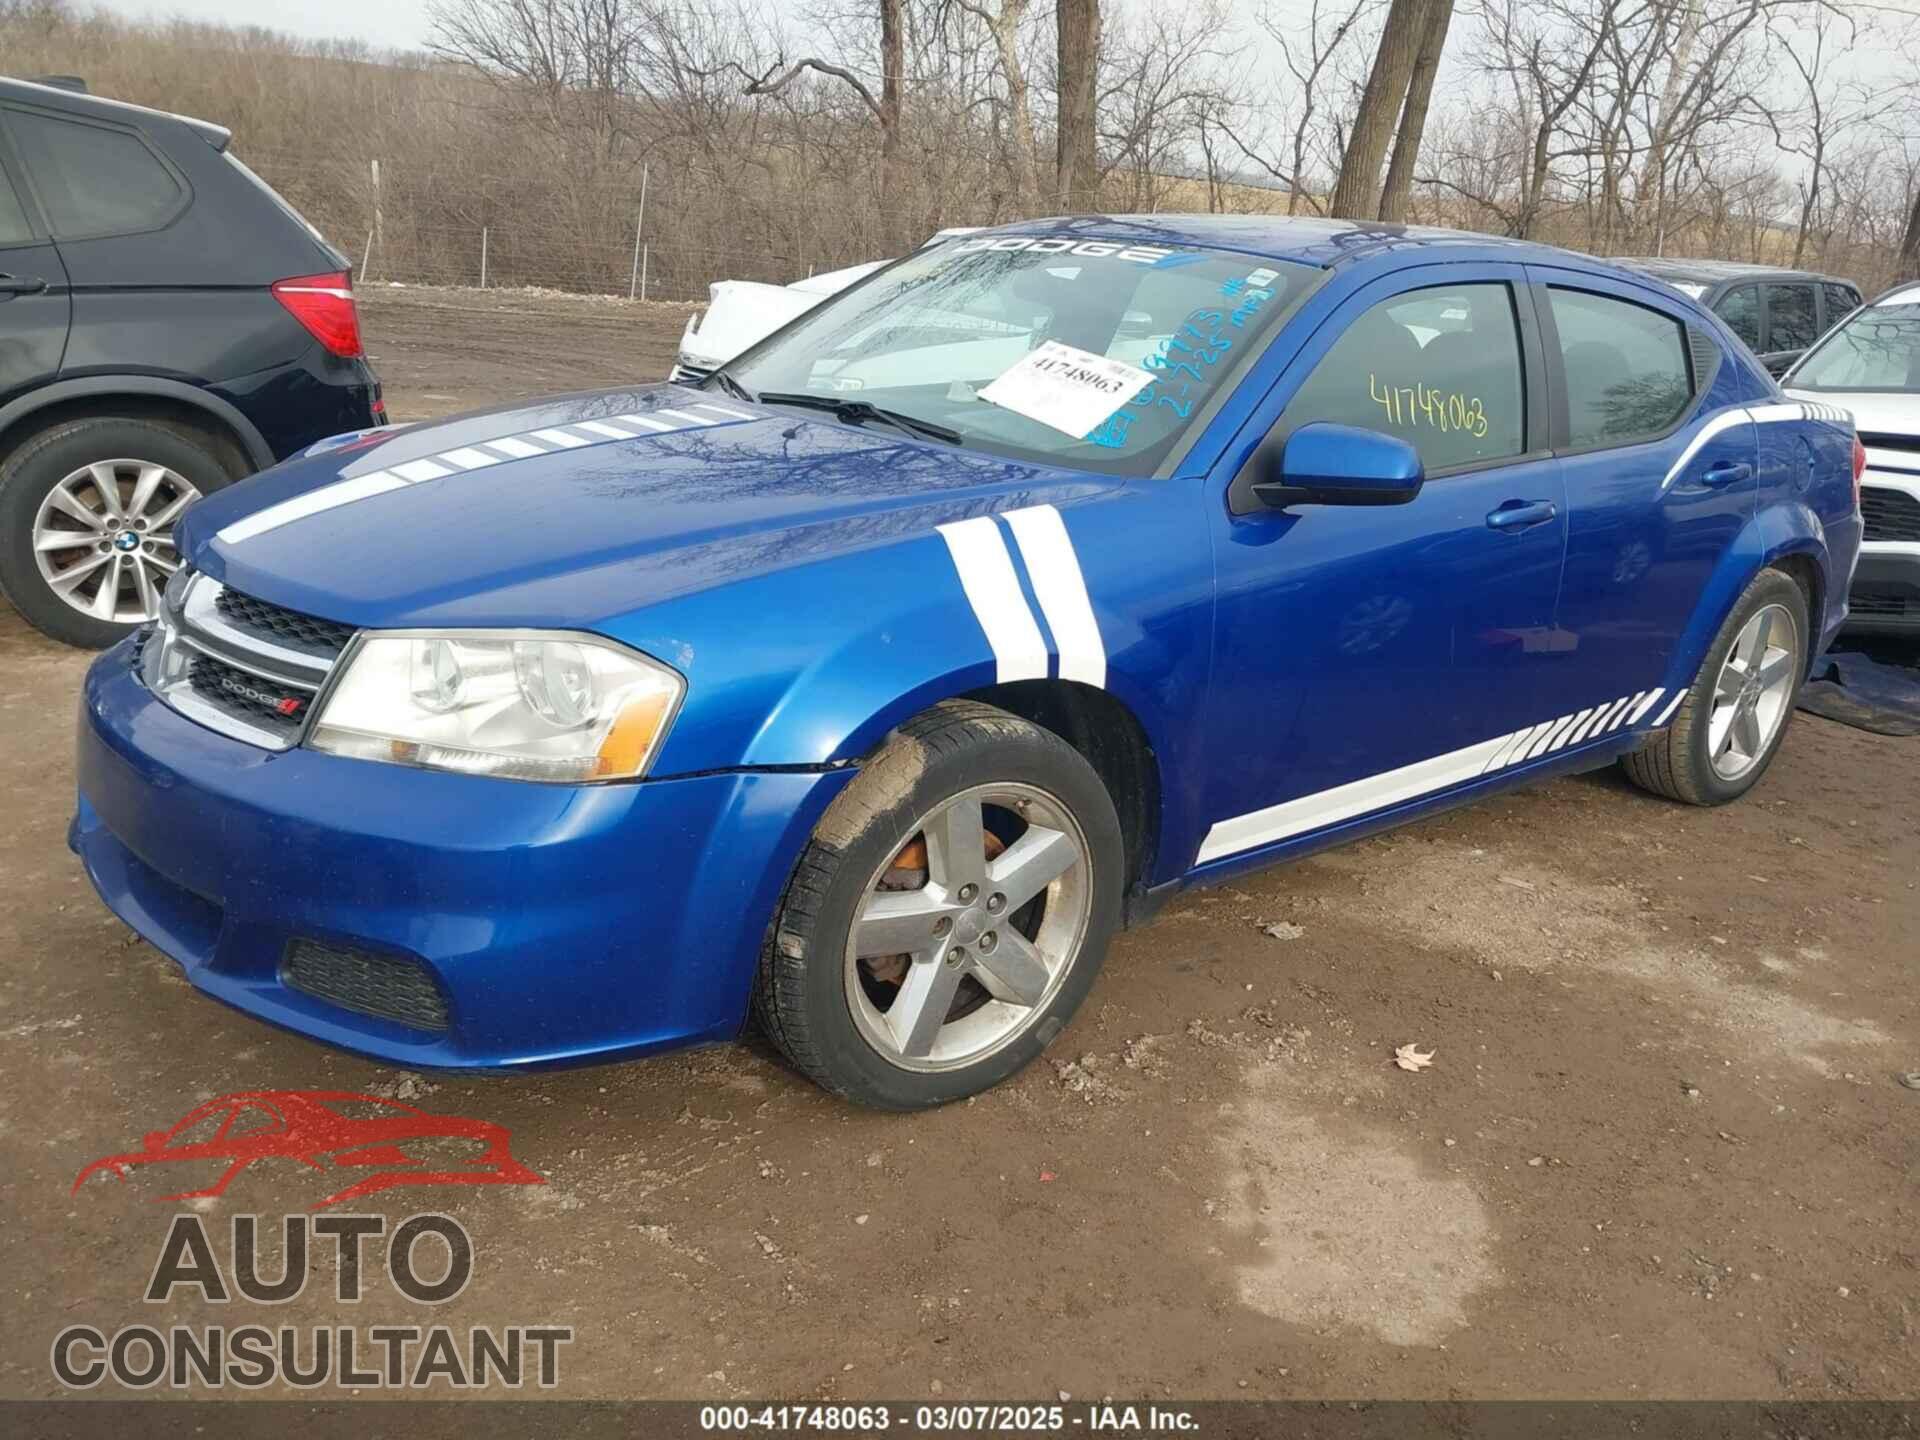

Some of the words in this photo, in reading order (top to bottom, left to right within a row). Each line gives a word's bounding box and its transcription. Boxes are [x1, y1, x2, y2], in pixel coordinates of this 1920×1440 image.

[953, 238, 1174, 265] DODGE
[1033, 357, 1124, 393] 41748063
[1369, 373, 1488, 438] 41748063
[222, 678, 284, 707] DODGE
